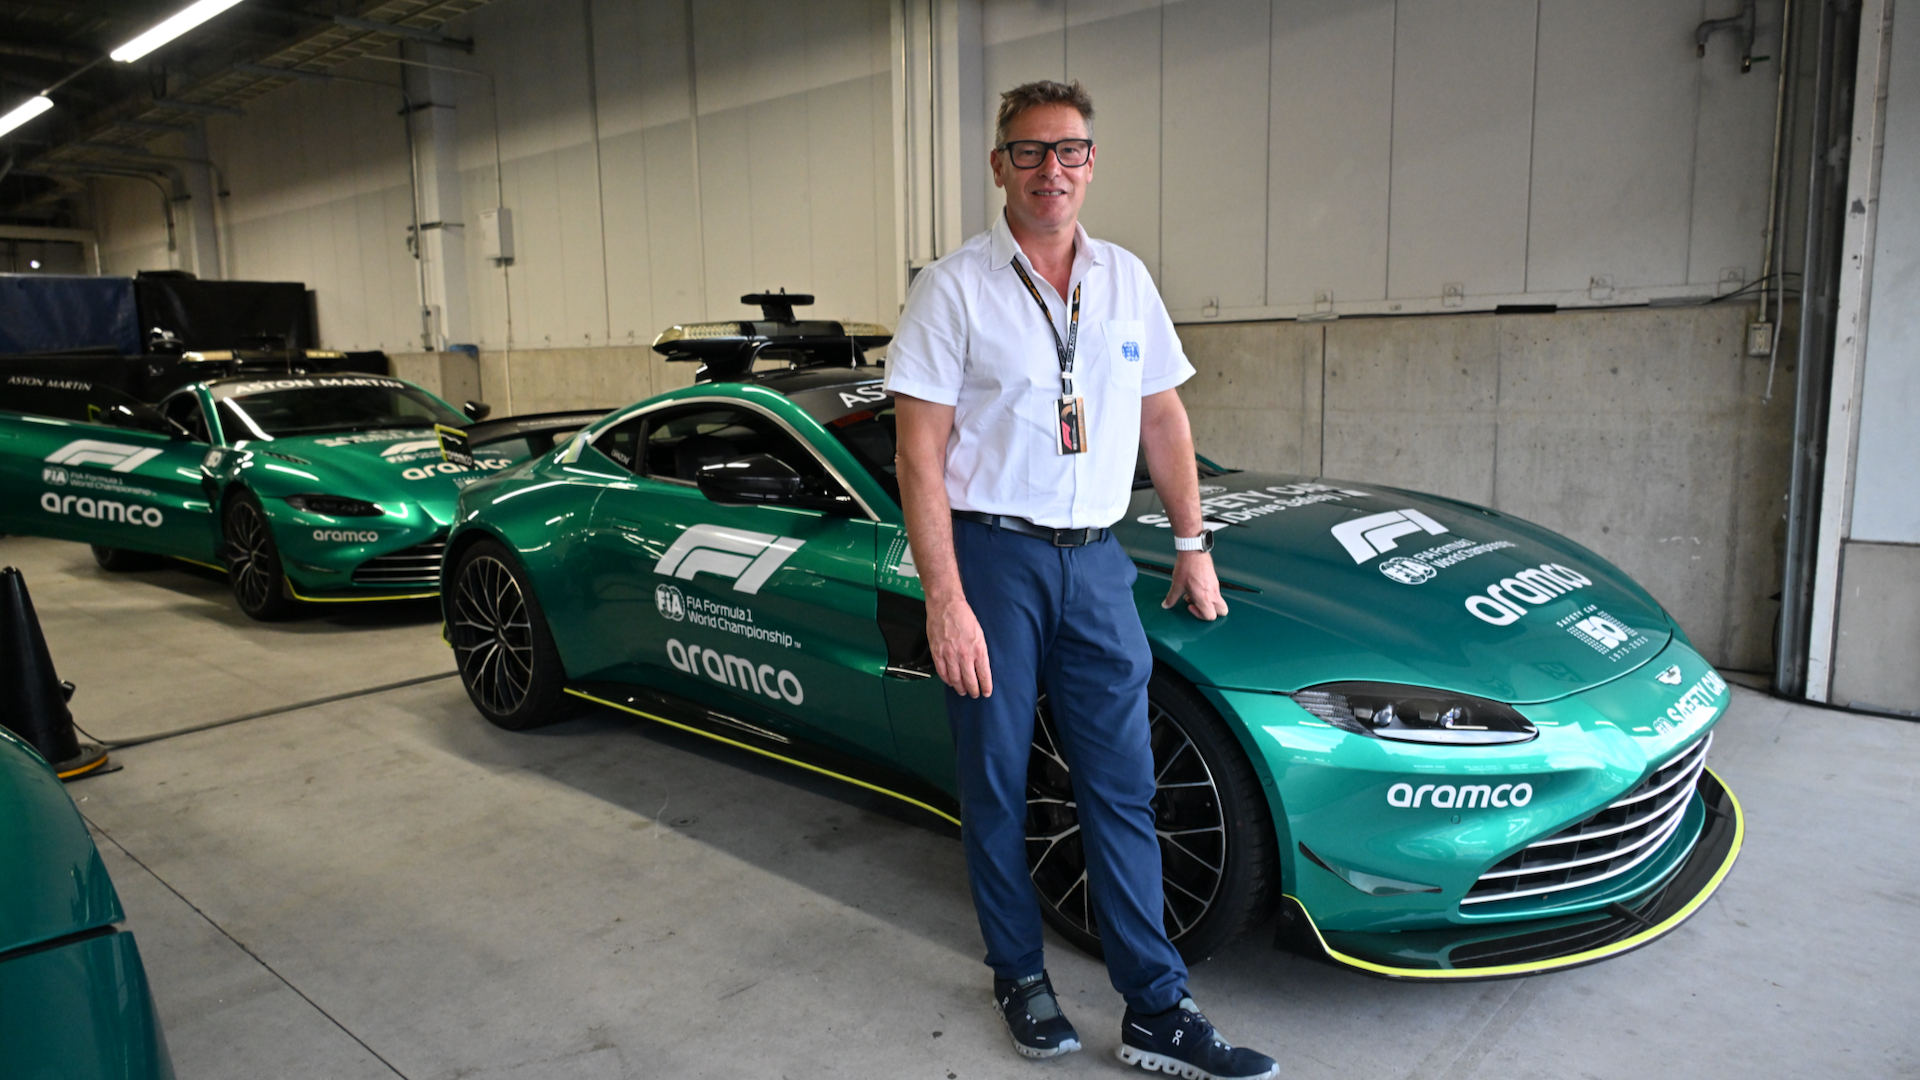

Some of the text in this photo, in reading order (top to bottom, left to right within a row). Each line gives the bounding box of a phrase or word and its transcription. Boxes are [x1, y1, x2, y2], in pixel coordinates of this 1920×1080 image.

[7, 375, 92, 391] ASTON MARTIN
[236, 377, 404, 394] ASTON MARTIN
[44, 439, 164, 473] F1
[41, 492, 163, 527] aramco
[313, 530, 379, 543] aramco
[1331, 508, 1449, 565] F1
[653, 523, 807, 595] F1
[656, 589, 683, 615] FIA
[686, 596, 753, 622] FIA Formula 1
[1464, 563, 1592, 626] aramco
[687, 610, 716, 629] World
[718, 617, 793, 648] Championship
[1556, 604, 1598, 628] SAFETY CAR
[1574, 615, 1629, 650] 50
[666, 638, 804, 706] aramco
[1666, 670, 1727, 721] SAFETY CAR
[1387, 782, 1533, 808] aramco
